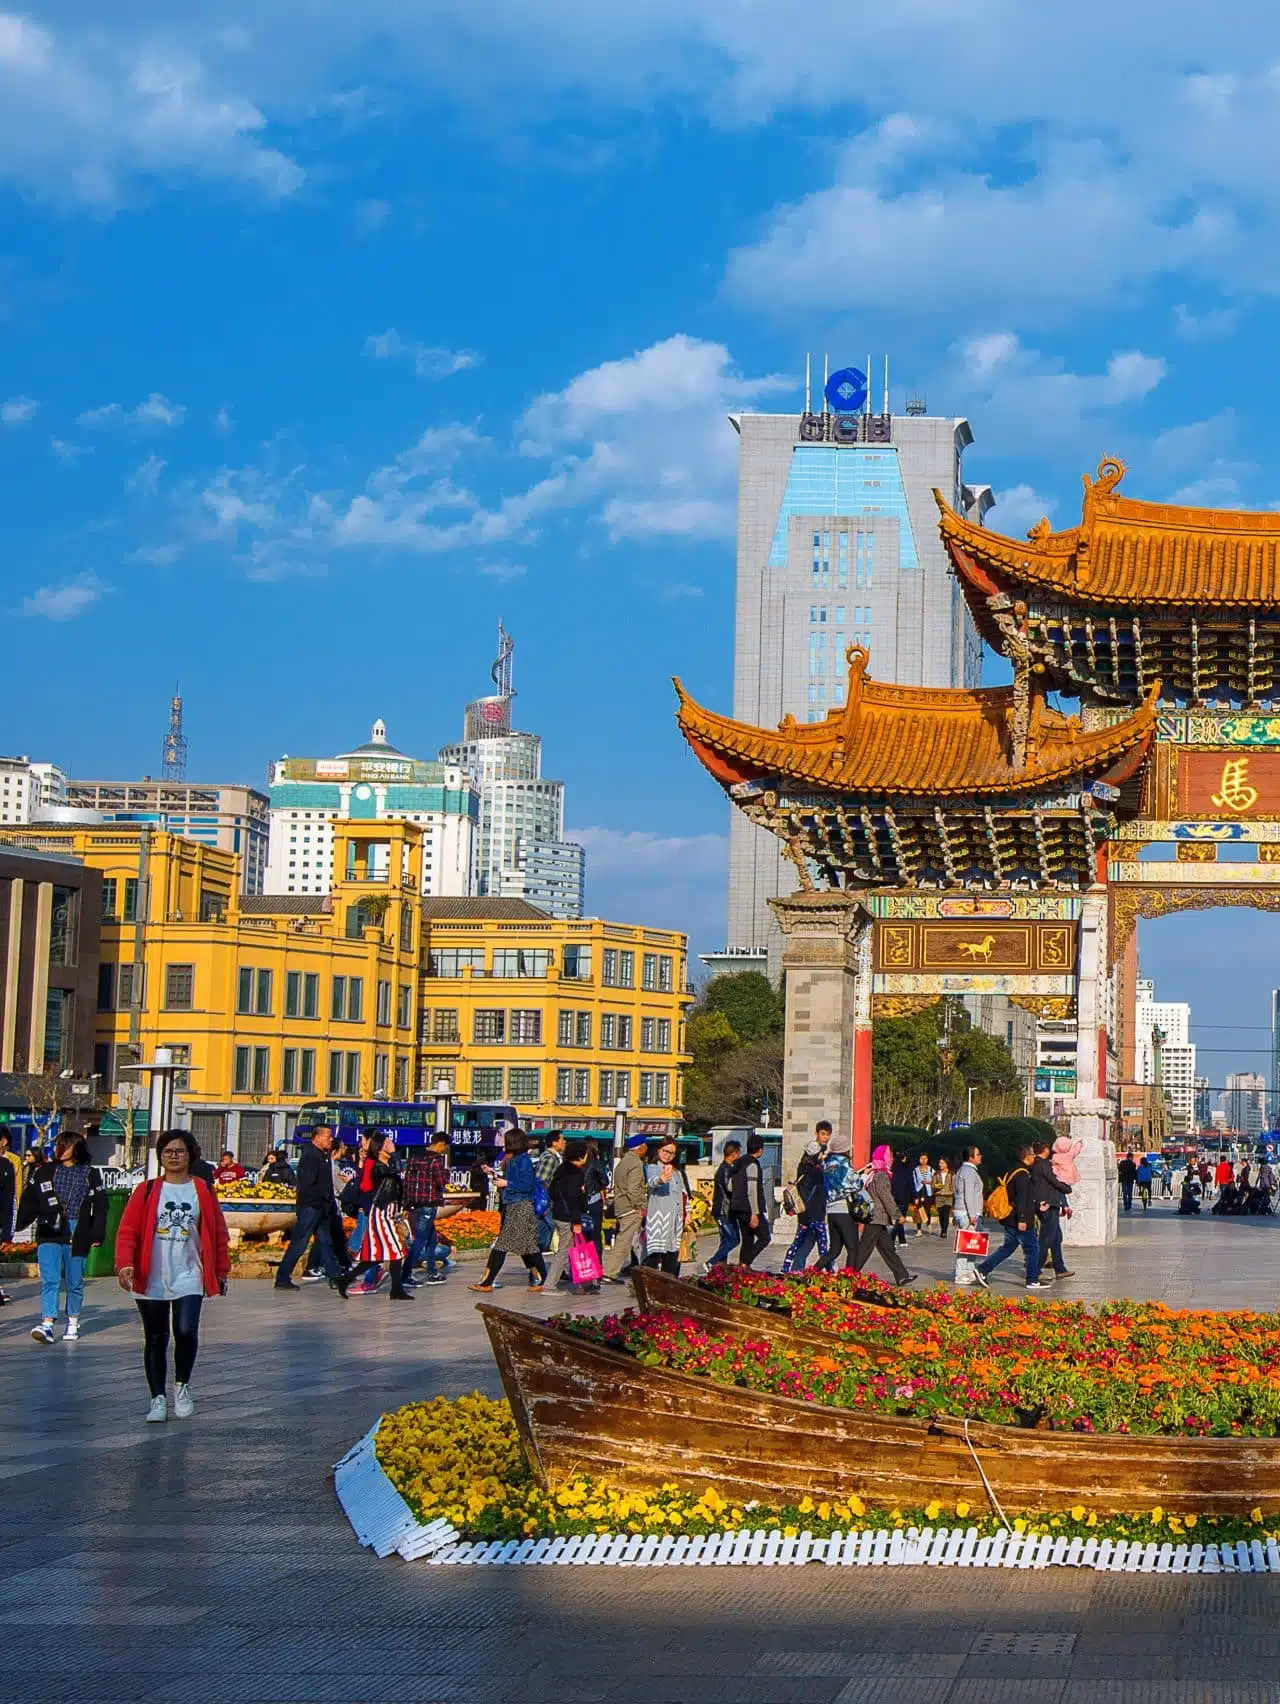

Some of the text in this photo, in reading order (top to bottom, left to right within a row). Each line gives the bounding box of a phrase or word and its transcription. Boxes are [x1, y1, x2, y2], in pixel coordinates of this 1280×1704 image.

[800, 415, 891, 443] CCB
[361, 761, 412, 773] 平安银行
[450, 1129, 482, 1145] 想整形
